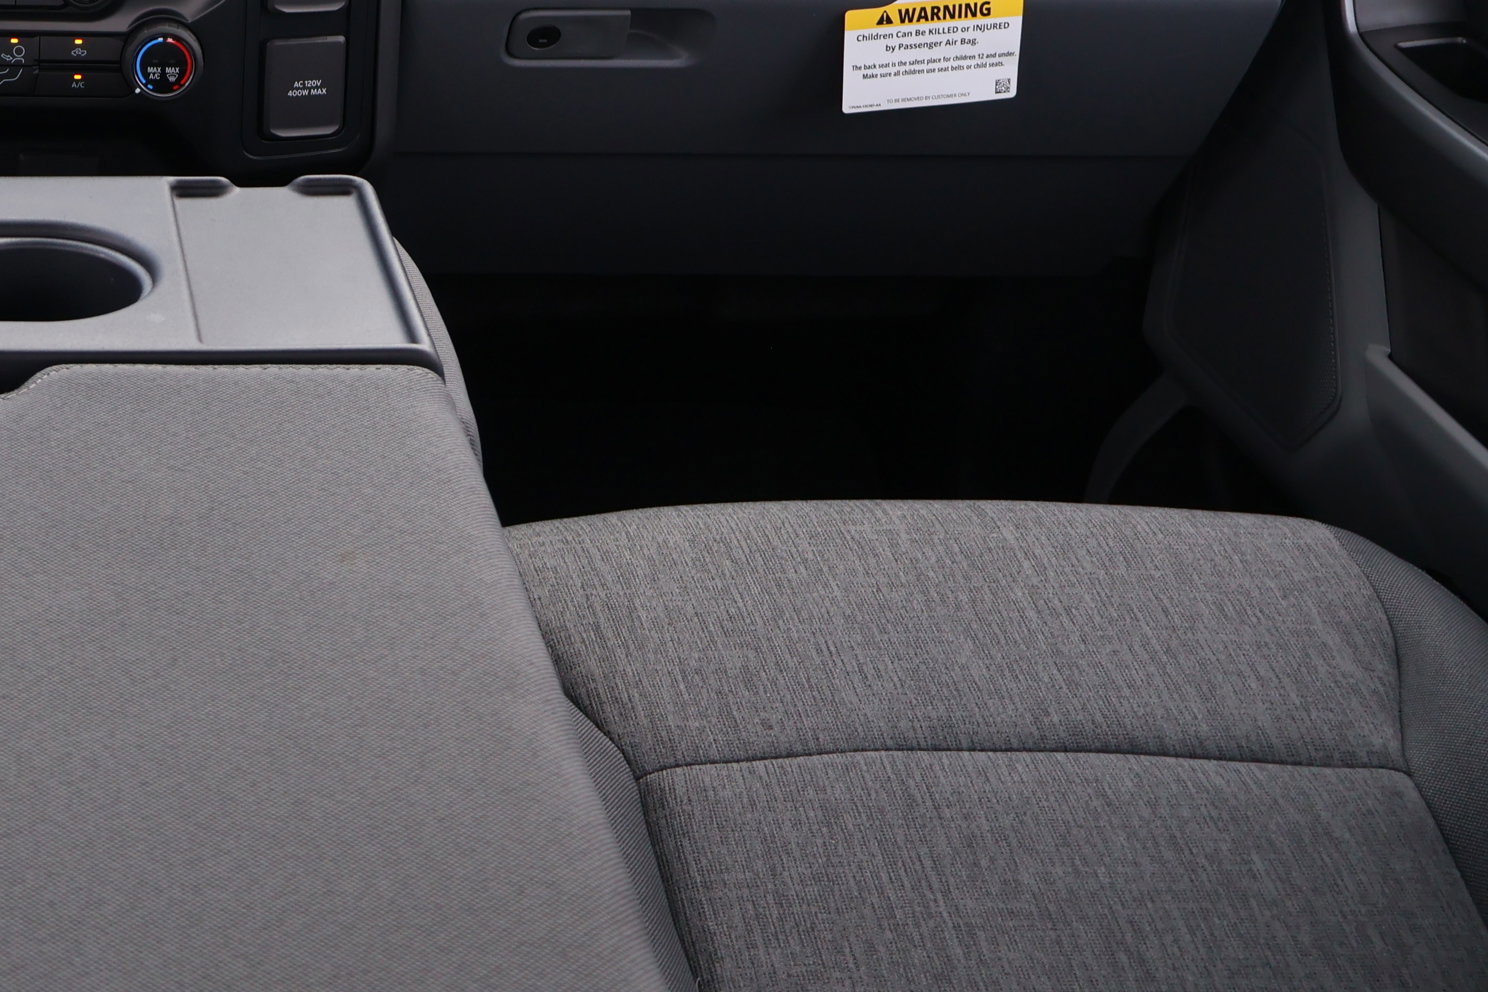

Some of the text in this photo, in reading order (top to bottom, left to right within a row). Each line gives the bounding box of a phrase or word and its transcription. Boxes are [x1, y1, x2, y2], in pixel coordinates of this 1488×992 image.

[898, 1, 991, 24] WARNING
[856, 32, 894, 42] Children
[896, 30, 912, 39] Can
[915, 29, 926, 37] Be
[928, 25, 959, 36] KILLED
[972, 21, 1010, 33] INJURED
[885, 38, 979, 53] by Passenger Air Bag.
[908, 58, 926, 66] safest
[952, 54, 976, 62] children
[997, 50, 1016, 58] under.
[147, 66, 162, 74] MAX
[165, 66, 180, 74] MAX
[862, 72, 878, 80] Make
[902, 68, 925, 76] children
[950, 64, 965, 72] belts
[293, 80, 322, 88] AC 120V
[287, 88, 309, 97] 400W
